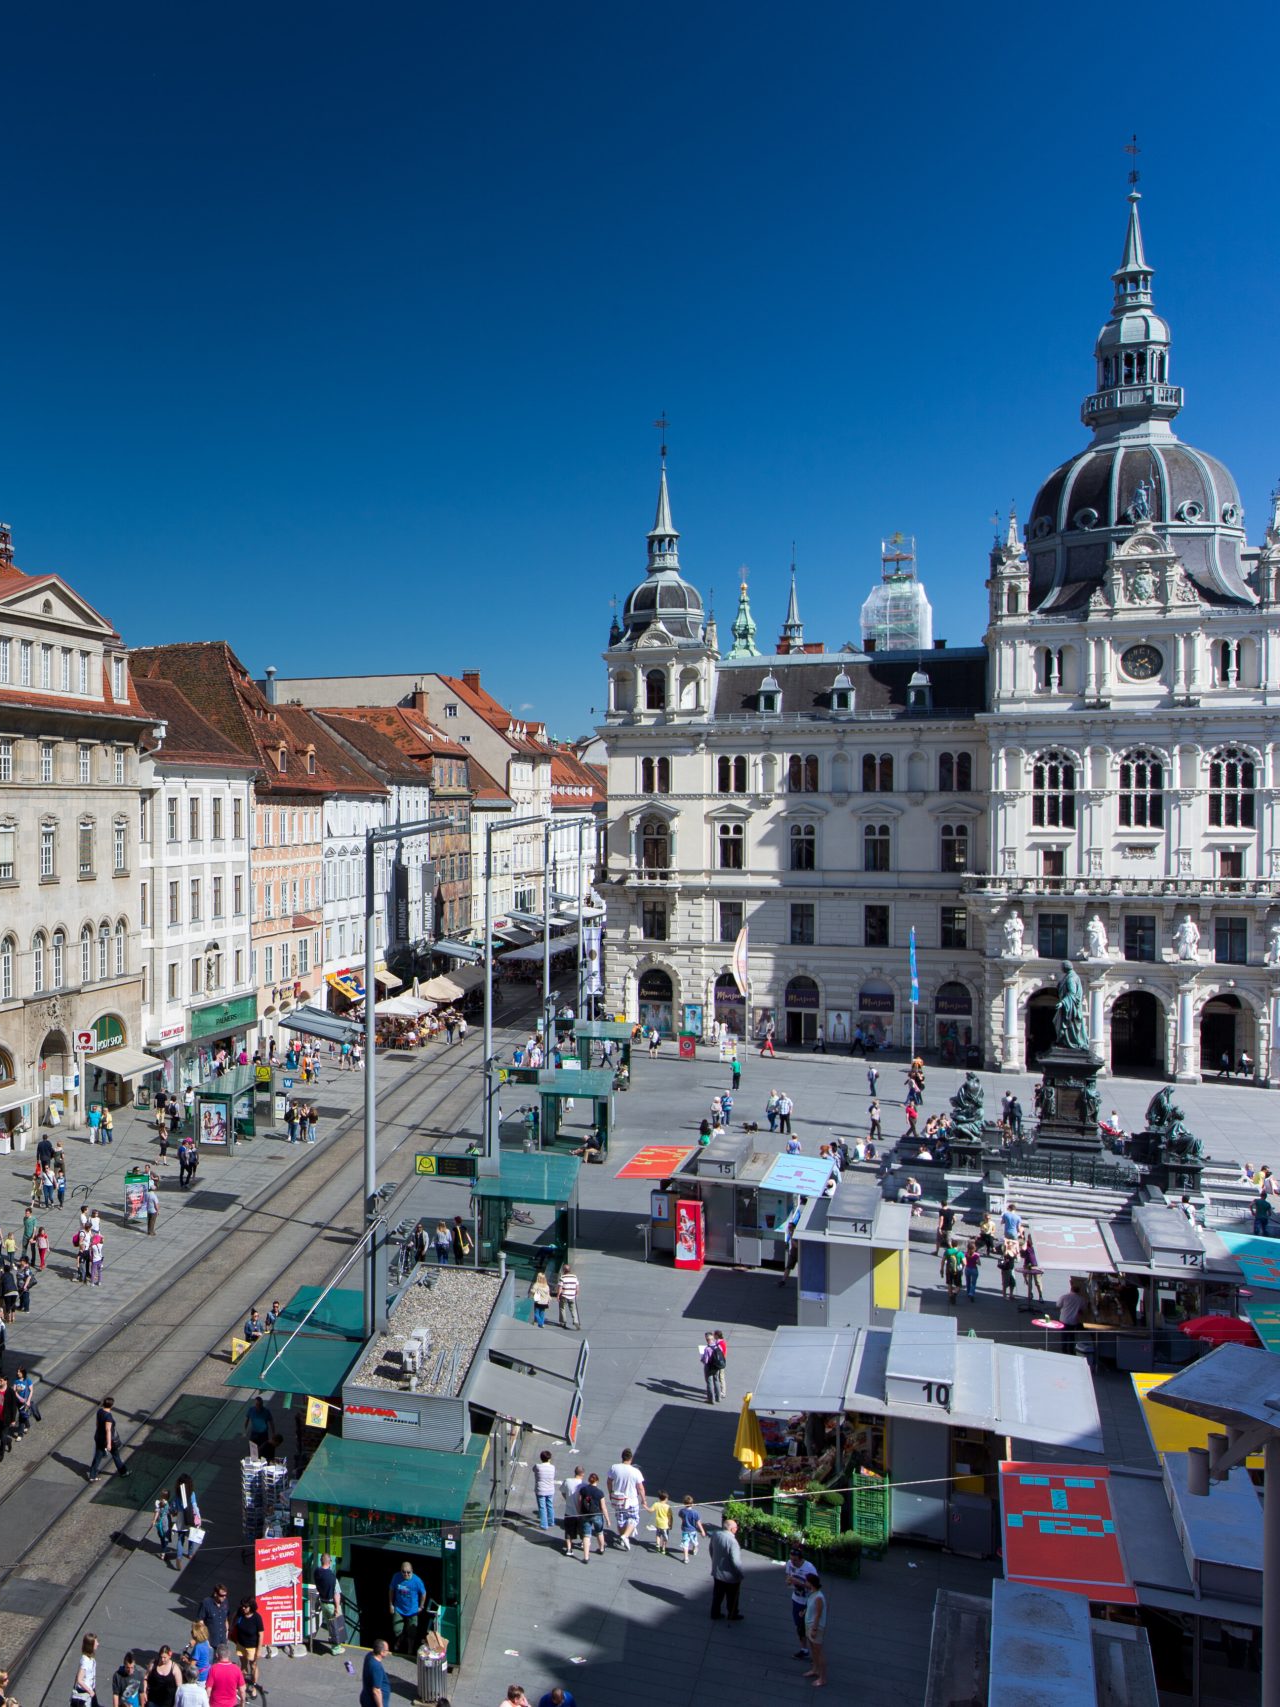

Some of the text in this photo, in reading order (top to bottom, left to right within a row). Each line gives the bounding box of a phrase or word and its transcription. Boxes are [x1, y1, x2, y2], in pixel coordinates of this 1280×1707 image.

[424, 892, 432, 929] HUMANIC
[398, 898, 406, 938] HUMANIC
[216, 1014, 238, 1025] PALMERS
[110, 1035, 122, 1046] SHOP
[718, 1164, 731, 1174] 15
[852, 1222, 867, 1234] 14
[1180, 1253, 1198, 1266] 12
[922, 1382, 950, 1406] 10
[258, 1547, 271, 1555] Hier
[279, 1550, 295, 1559] EURO
